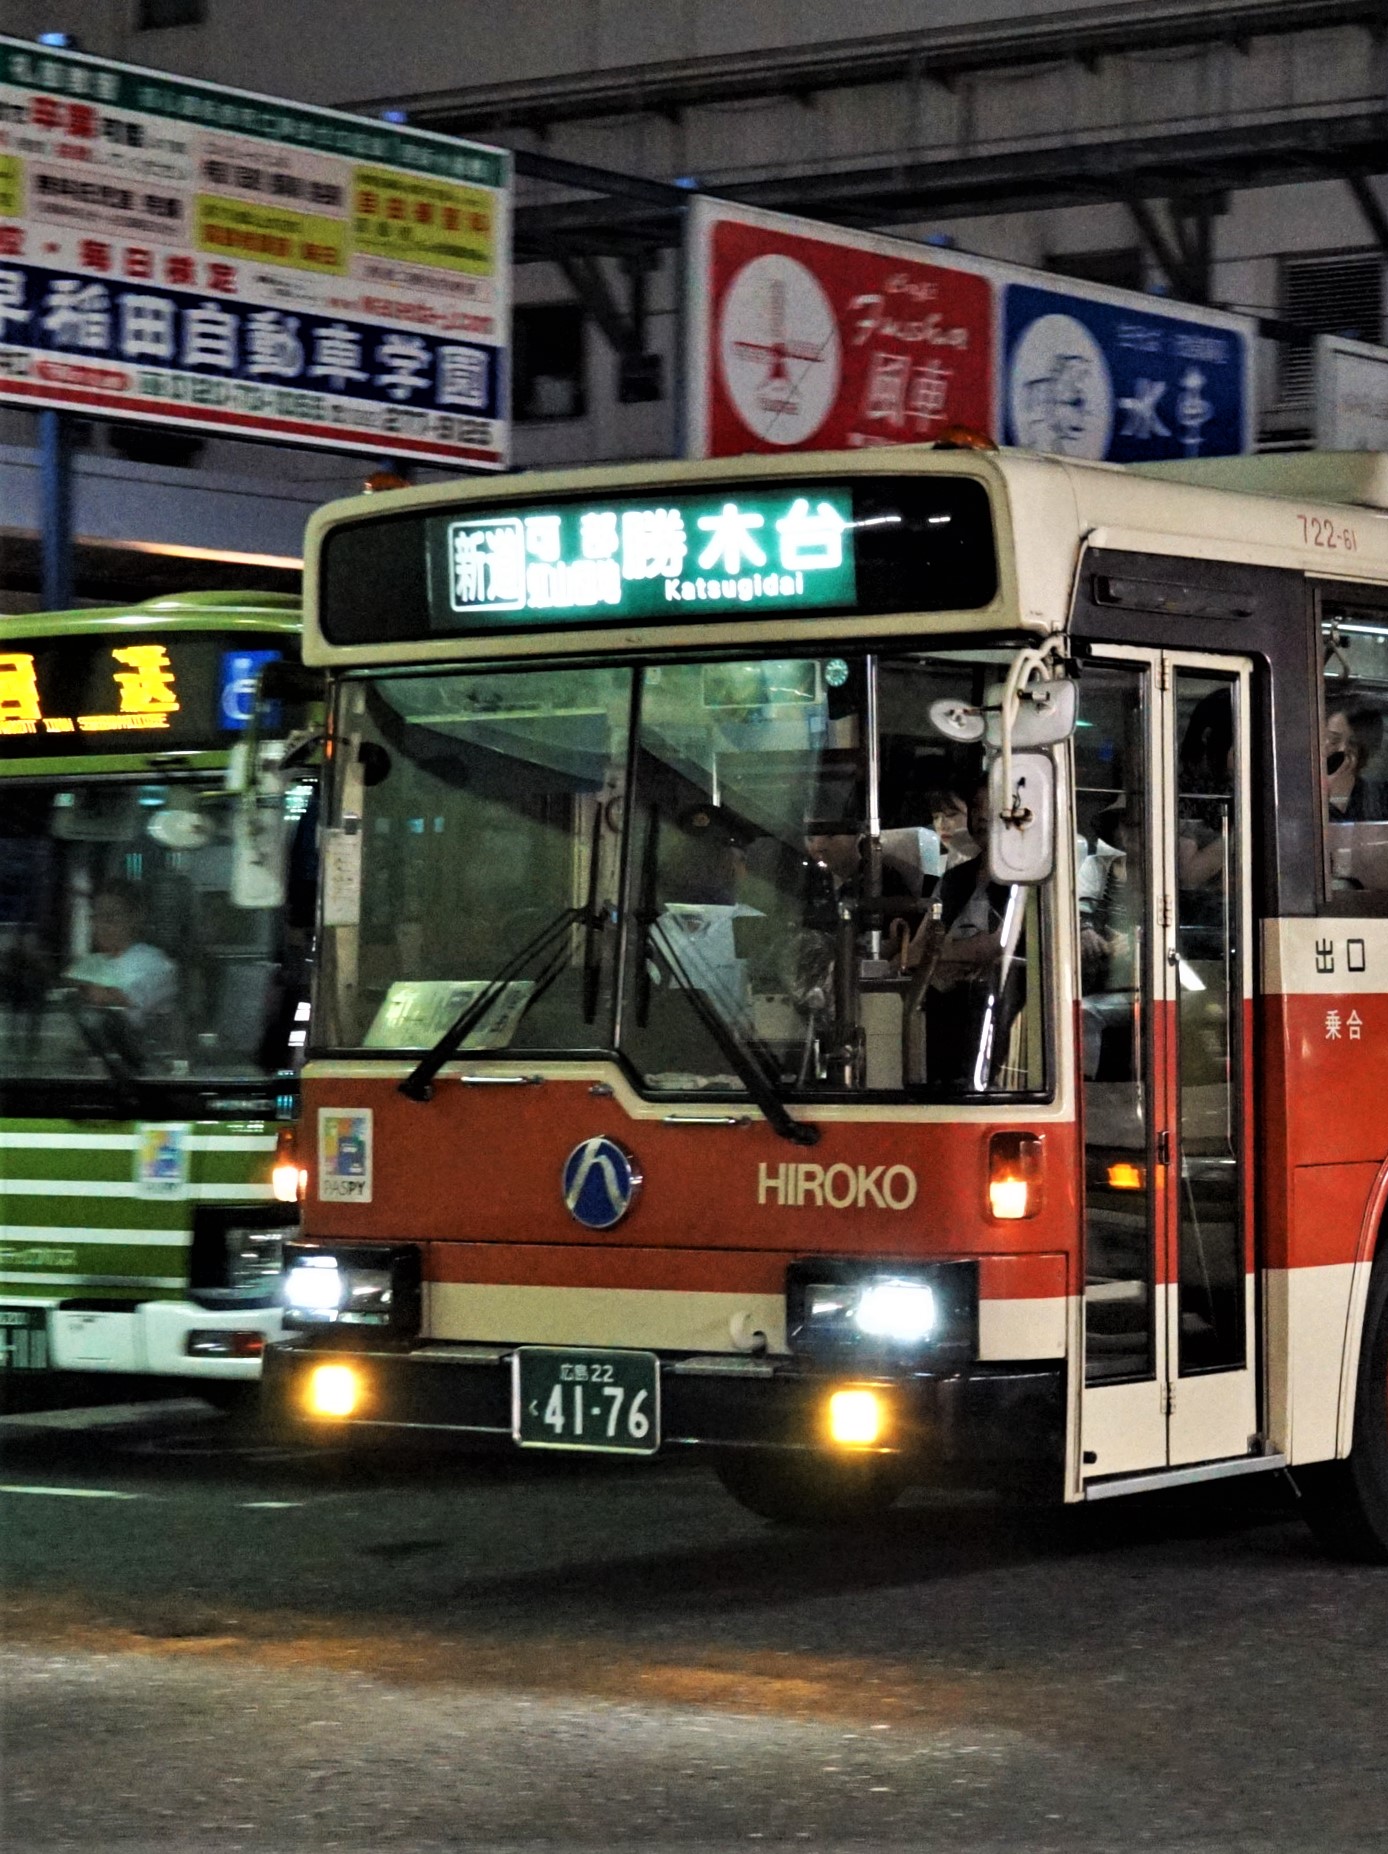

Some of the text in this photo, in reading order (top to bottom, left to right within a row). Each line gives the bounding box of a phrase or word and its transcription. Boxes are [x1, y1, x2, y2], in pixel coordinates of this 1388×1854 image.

[622, 498, 845, 582] 勝木台
[1297, 513, 1357, 552] 722-61
[665, 572, 804, 602] Katsugidai
[1315, 938, 1366, 974] 出口
[1325, 1009, 1362, 1041] 乗合
[757, 1162, 917, 1210] HIROKO
[591, 1364, 614, 1382] 22
[544, 1384, 650, 1439] 41-76
